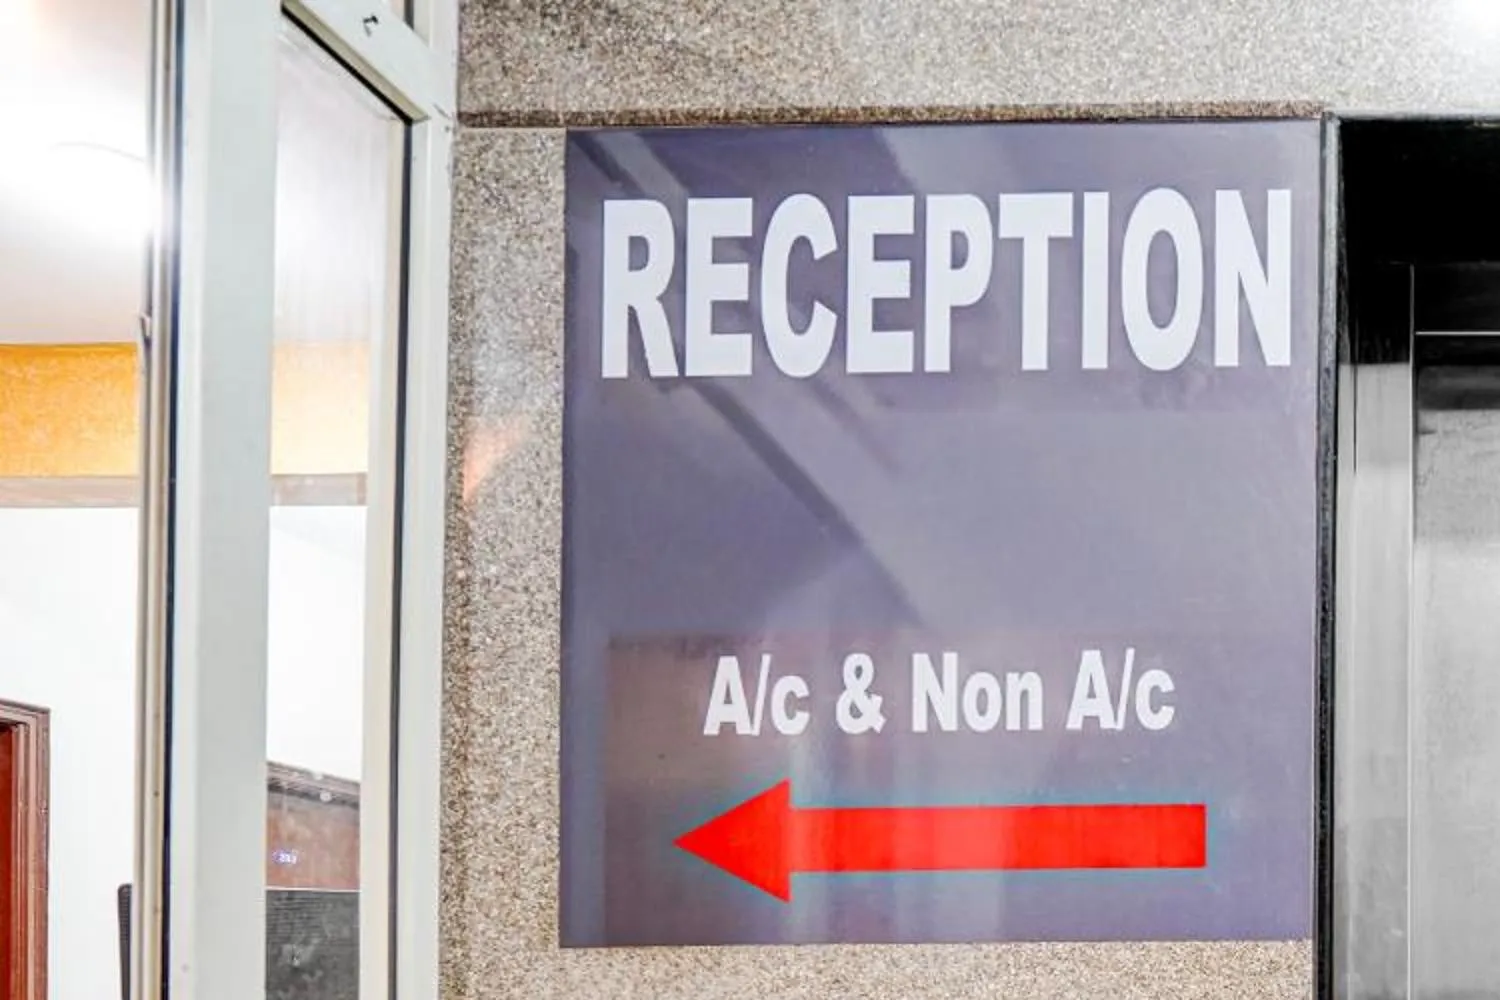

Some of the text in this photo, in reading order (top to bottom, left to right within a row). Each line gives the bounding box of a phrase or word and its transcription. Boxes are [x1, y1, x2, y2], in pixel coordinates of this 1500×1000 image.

[601, 187, 1293, 379] RECEPTION
[703, 647, 1176, 737] A/c & Non A/c
